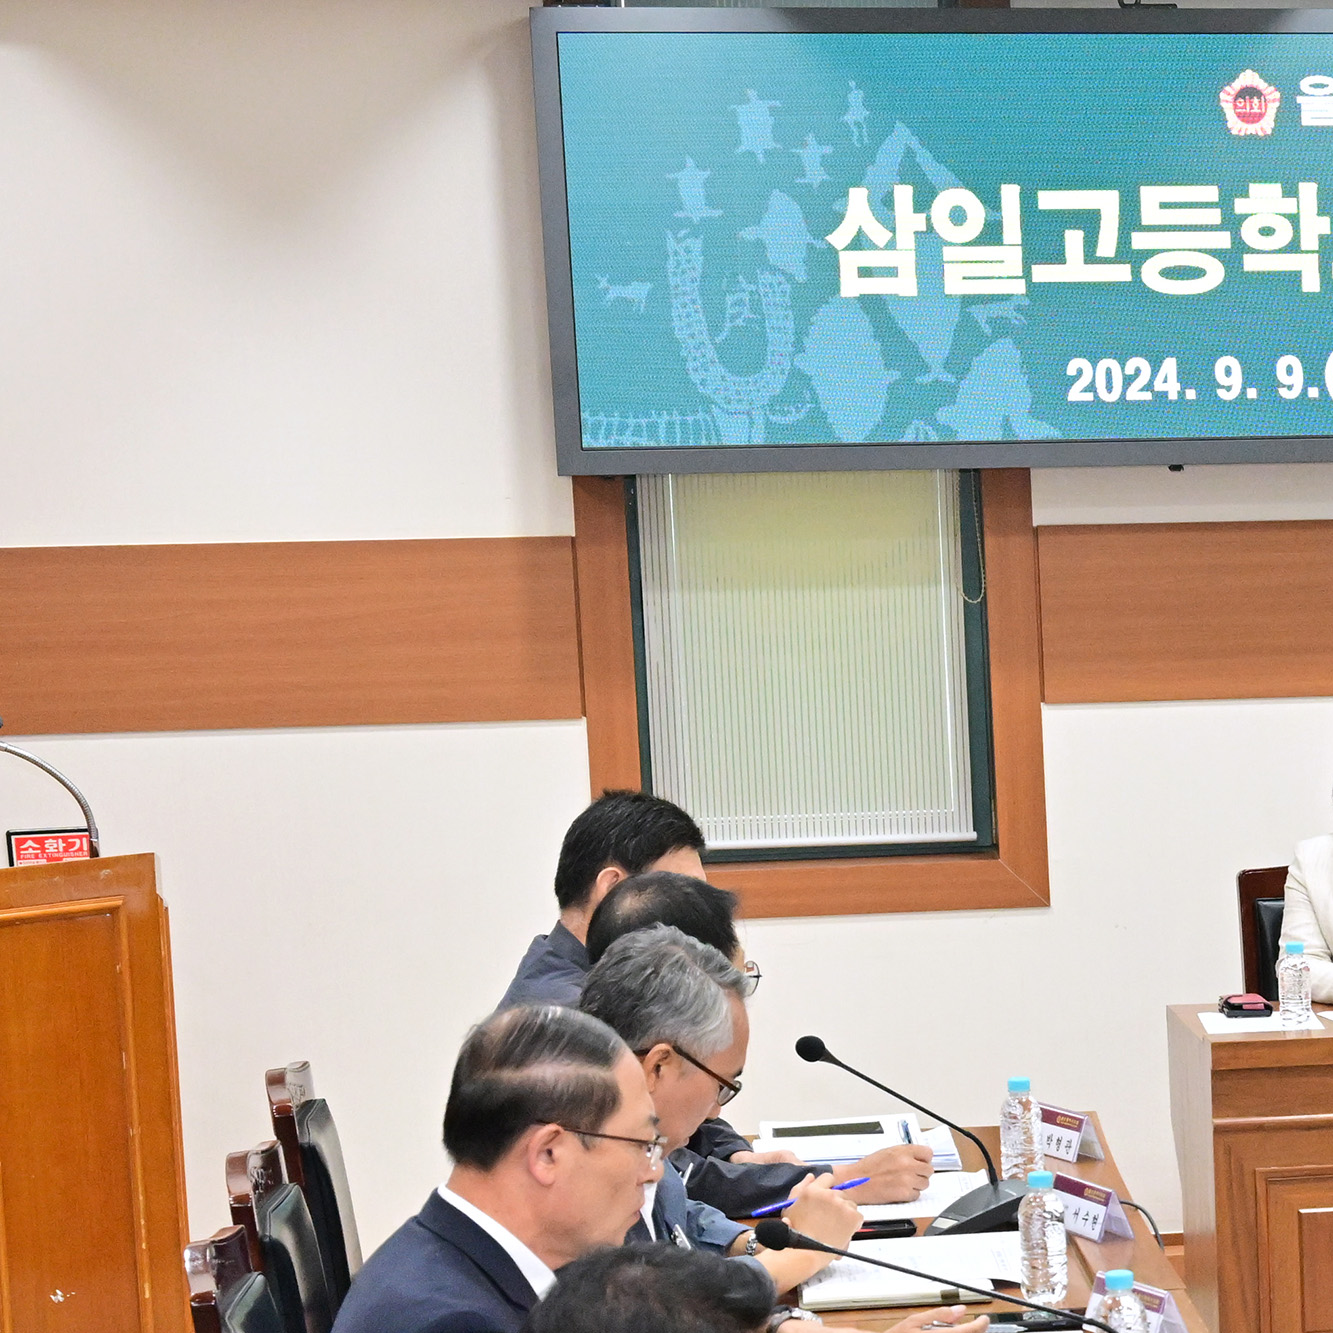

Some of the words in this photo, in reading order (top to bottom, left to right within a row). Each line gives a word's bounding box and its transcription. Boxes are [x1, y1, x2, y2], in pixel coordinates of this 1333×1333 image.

[1235, 96, 1265, 113] 의회
[1066, 357, 1197, 403] 2024.
[1214, 355, 1257, 401] 9.
[19, 837, 88, 854] 소화기
